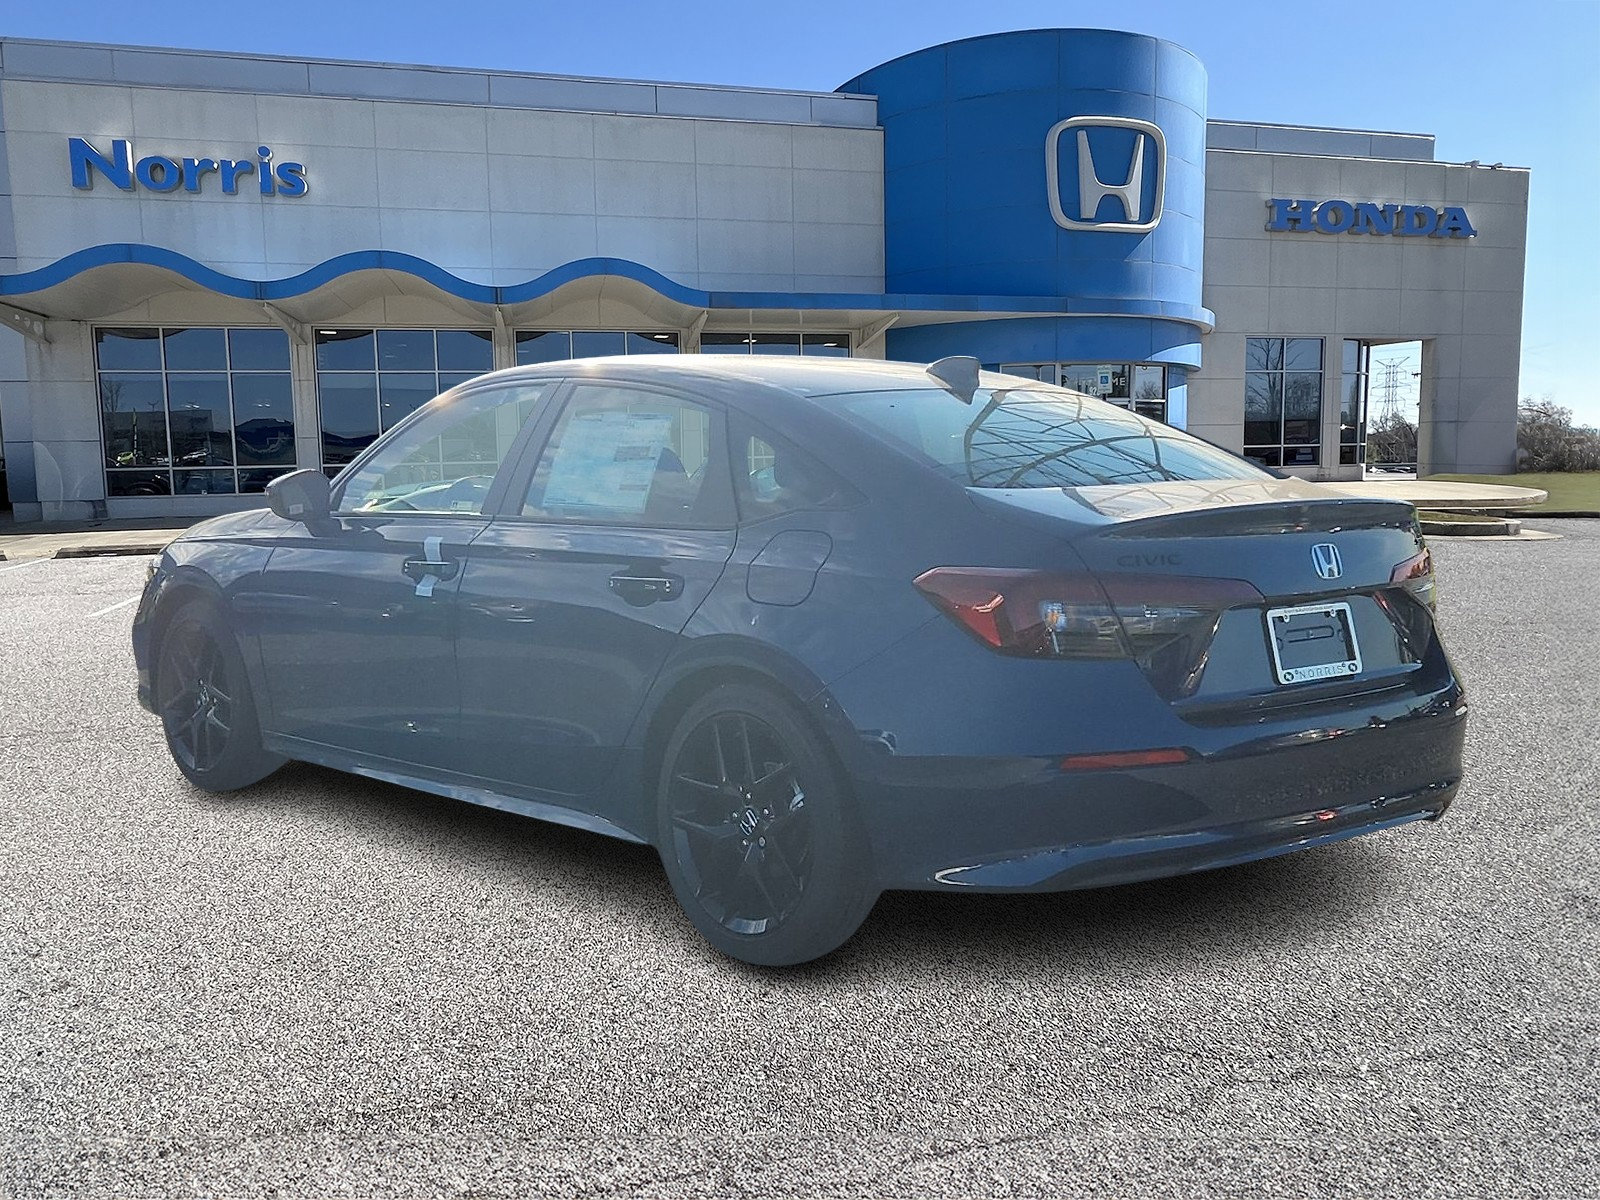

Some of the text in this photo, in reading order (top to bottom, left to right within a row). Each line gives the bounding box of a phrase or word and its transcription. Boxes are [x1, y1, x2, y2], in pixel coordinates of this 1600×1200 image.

[68, 137, 308, 197] Norris
[1266, 198, 1477, 239] HONDA
[1117, 554, 1182, 567] CIVIC
[1299, 666, 1344, 679] NORRIS
